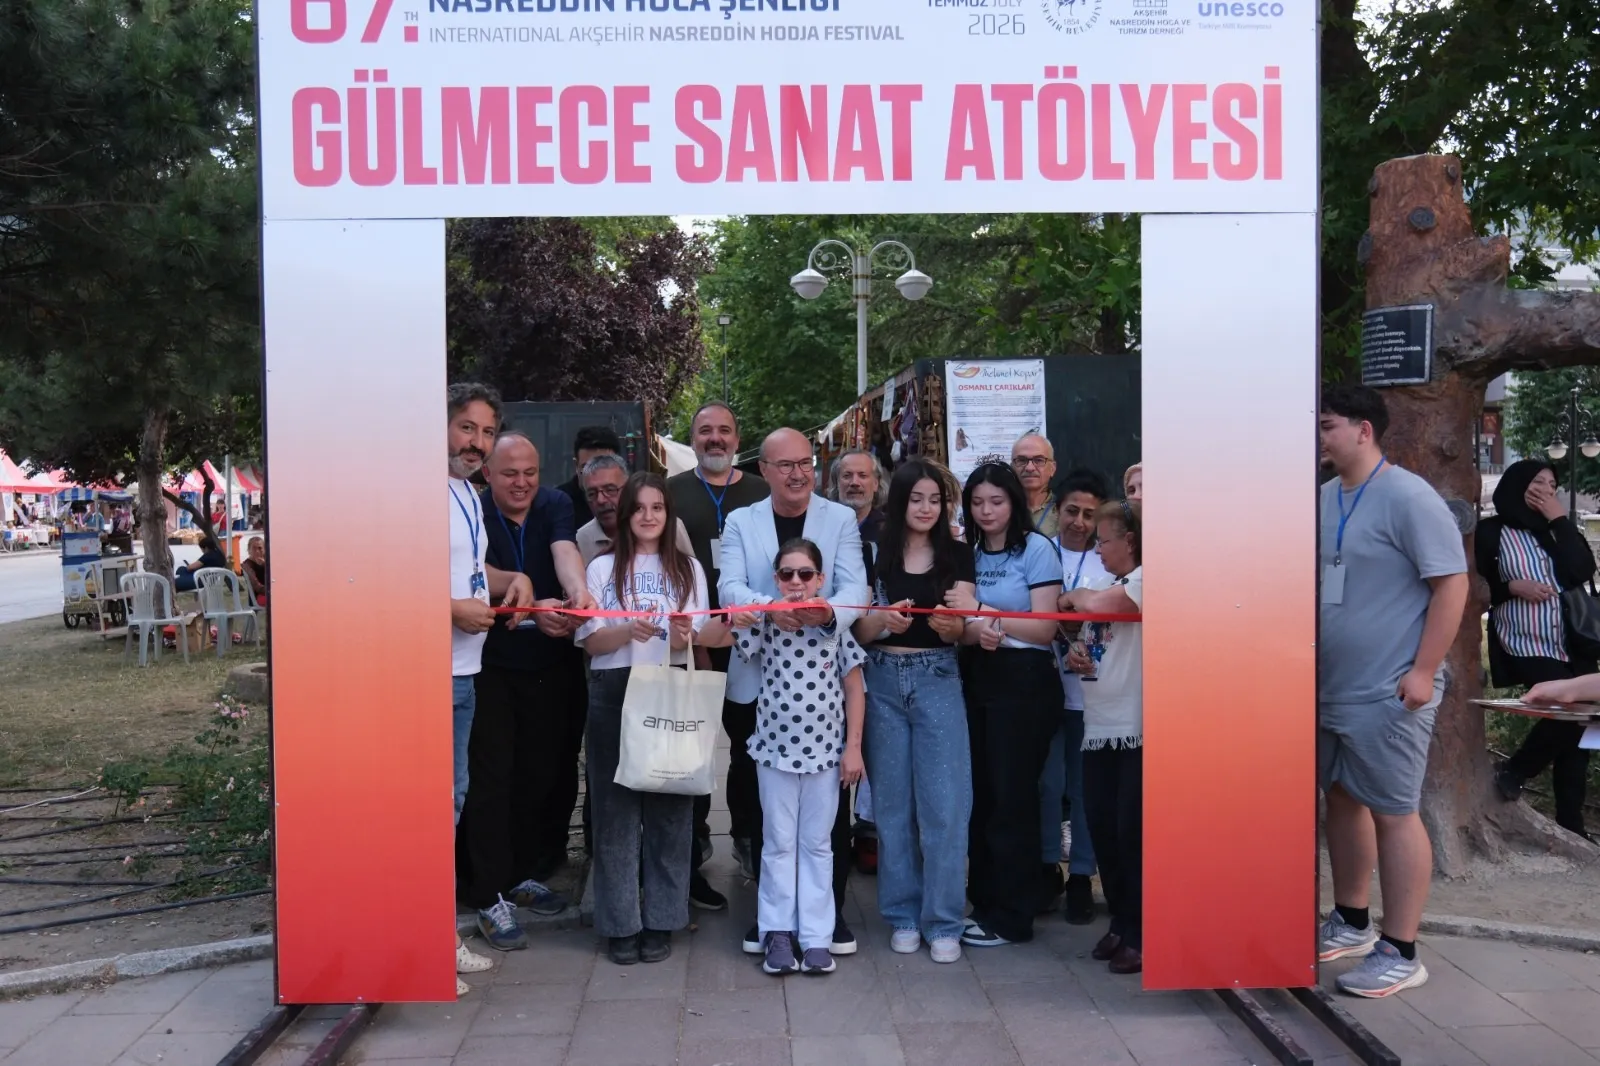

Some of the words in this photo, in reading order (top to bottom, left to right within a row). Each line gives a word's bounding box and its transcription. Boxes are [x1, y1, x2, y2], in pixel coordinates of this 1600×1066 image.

[1133, 8, 1168, 17] AKŞEHİR
[1198, 2, 1284, 17] unesco
[404, 11, 419, 21] TH
[1157, 18, 1180, 26] HOCA
[1181, 18, 1191, 26] VE
[968, 14, 1025, 35] 2026
[430, 26, 564, 43] INTERNATIONAL
[569, 23, 644, 45] AKŞEHİR
[649, 22, 756, 41] NASREDDİN
[761, 25, 819, 41] HODJA
[824, 25, 905, 41] FESTIVAL
[1119, 27, 1148, 35] TURİZM
[291, 69, 651, 188] GÜLMECE
[674, 84, 923, 184] SANAT
[944, 65, 1283, 182] ATÖLYESİ
